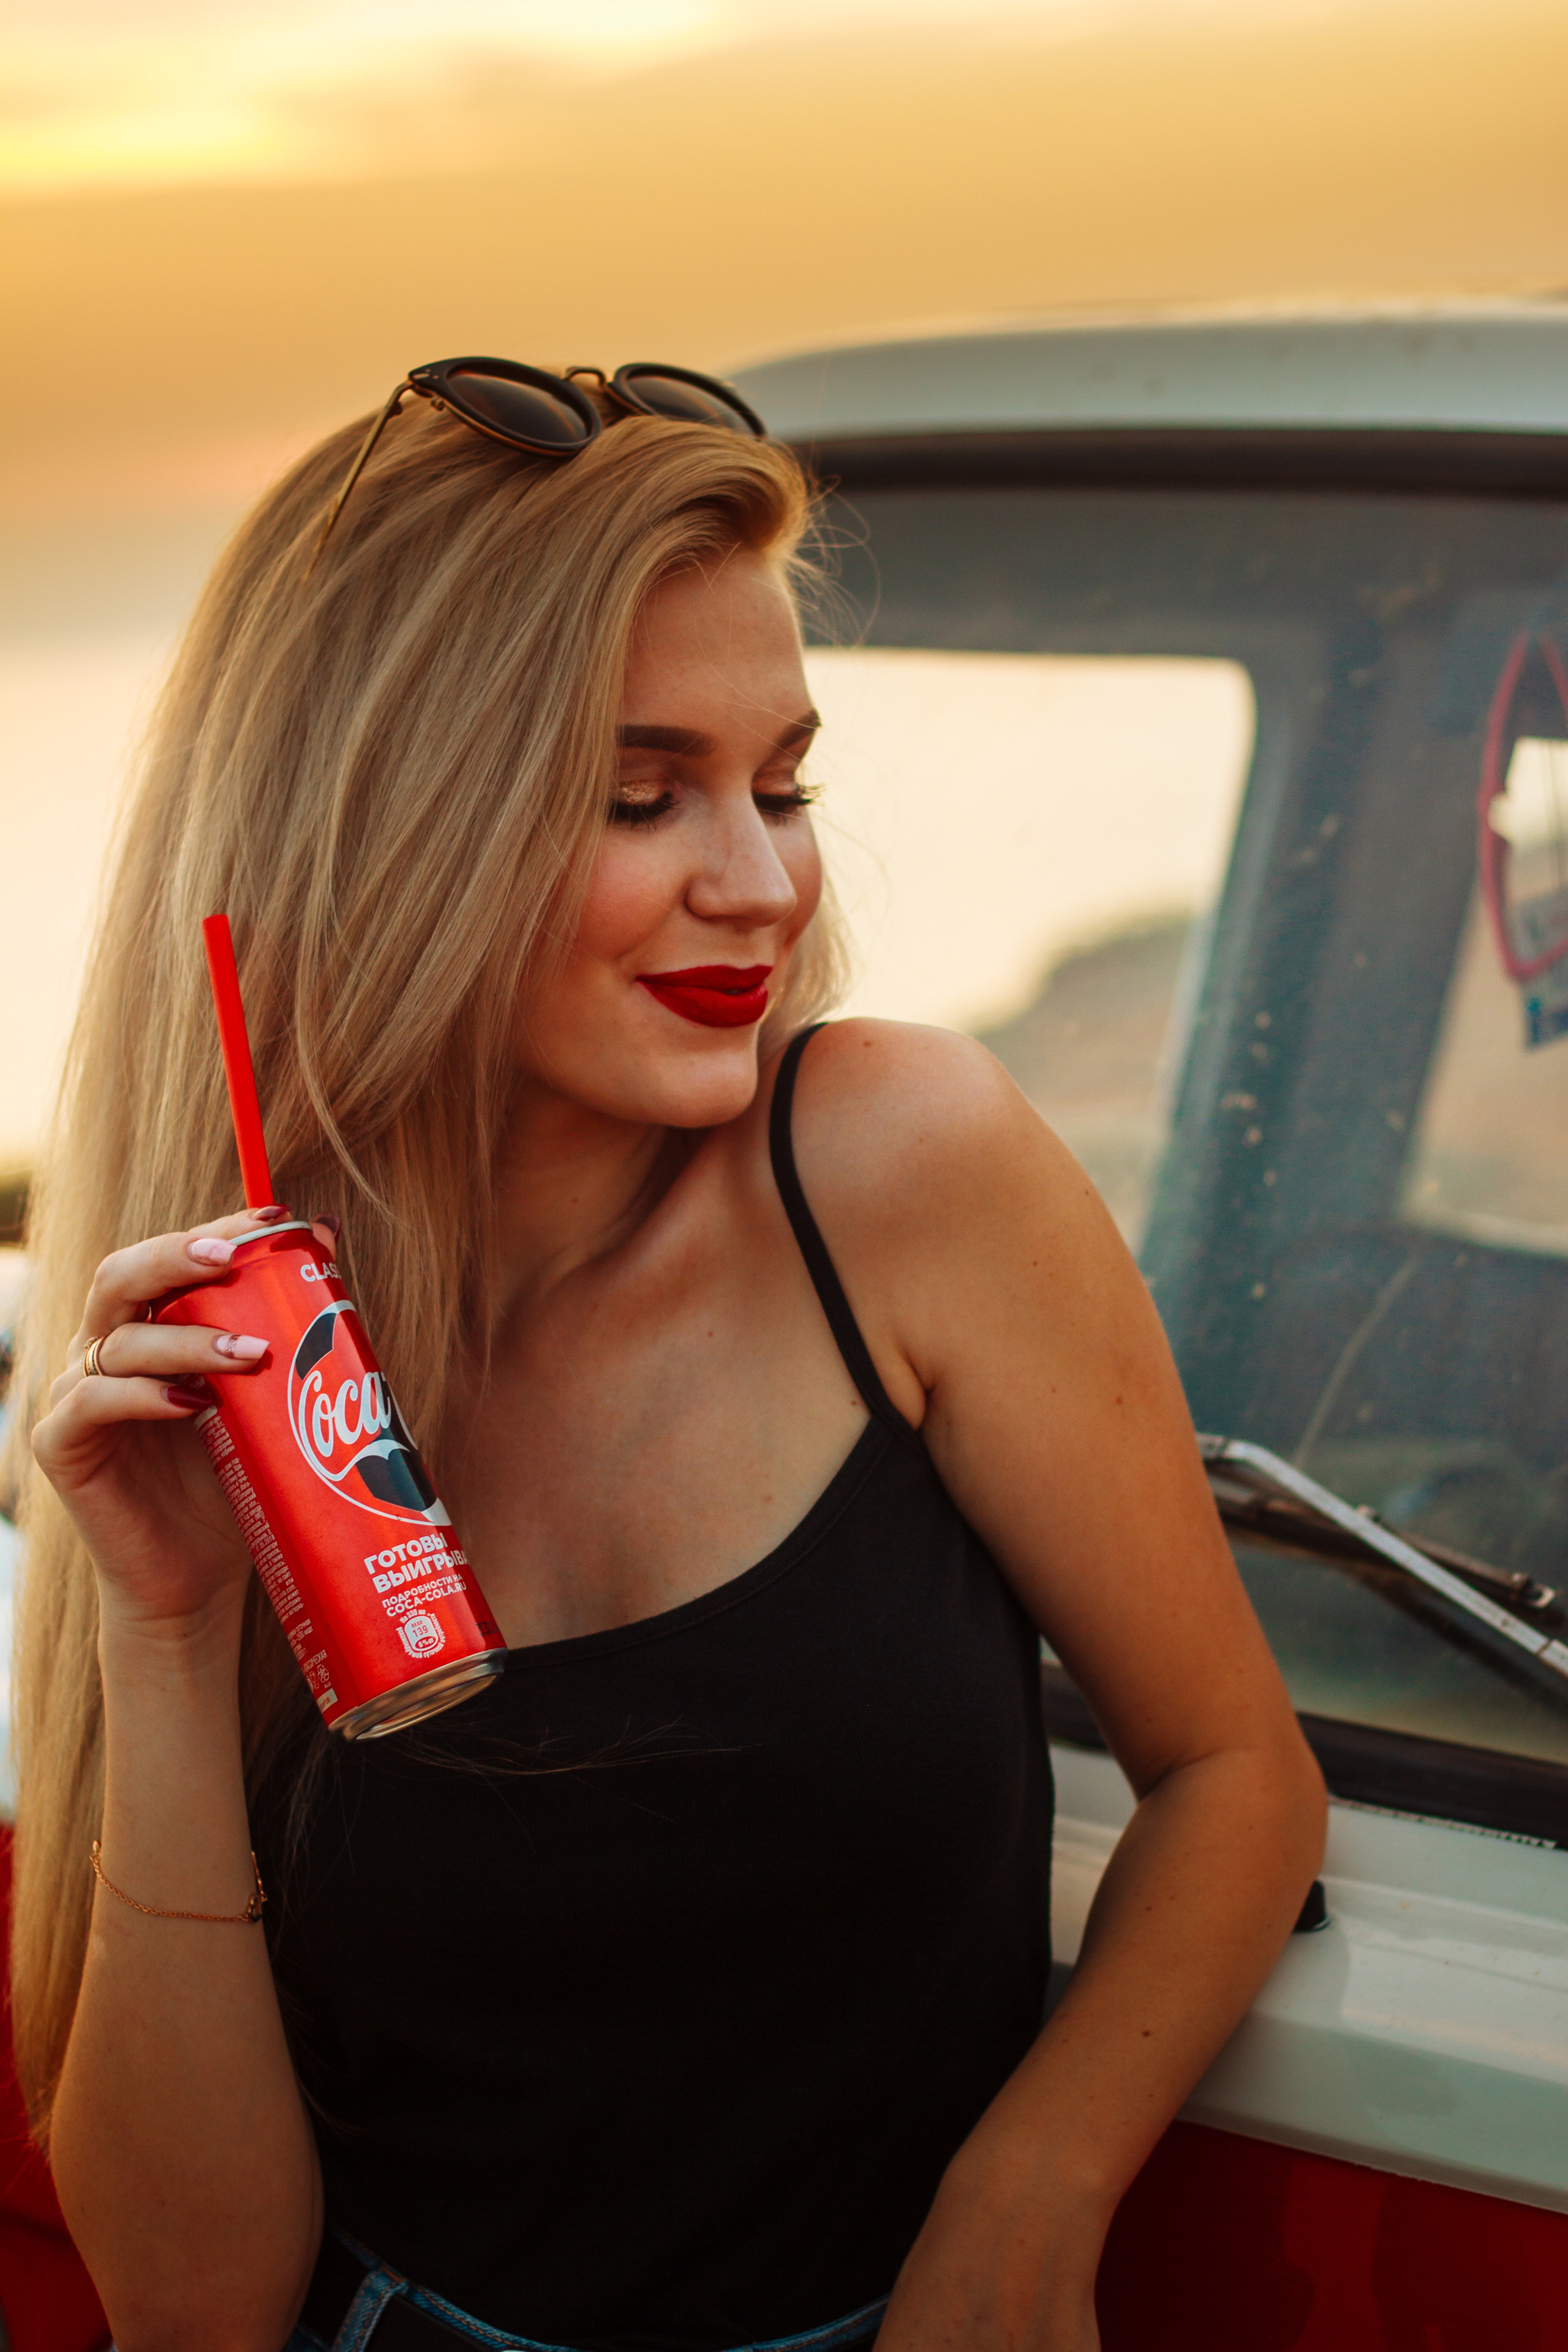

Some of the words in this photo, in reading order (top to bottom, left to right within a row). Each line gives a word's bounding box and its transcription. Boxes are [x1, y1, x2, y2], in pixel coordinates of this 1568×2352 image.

[300, 1262, 342, 1282] CLAS
[364, 1532, 448, 1574] ГОТОВЫ
[382, 1576, 452, 1608] ПОДРОБНОСТИ
[452, 1574, 463, 1582] НА
[386, 1581, 467, 1616] COCA-COLA.RU
[406, 1609, 417, 1618] 330
[412, 1625, 428, 1637] 139
